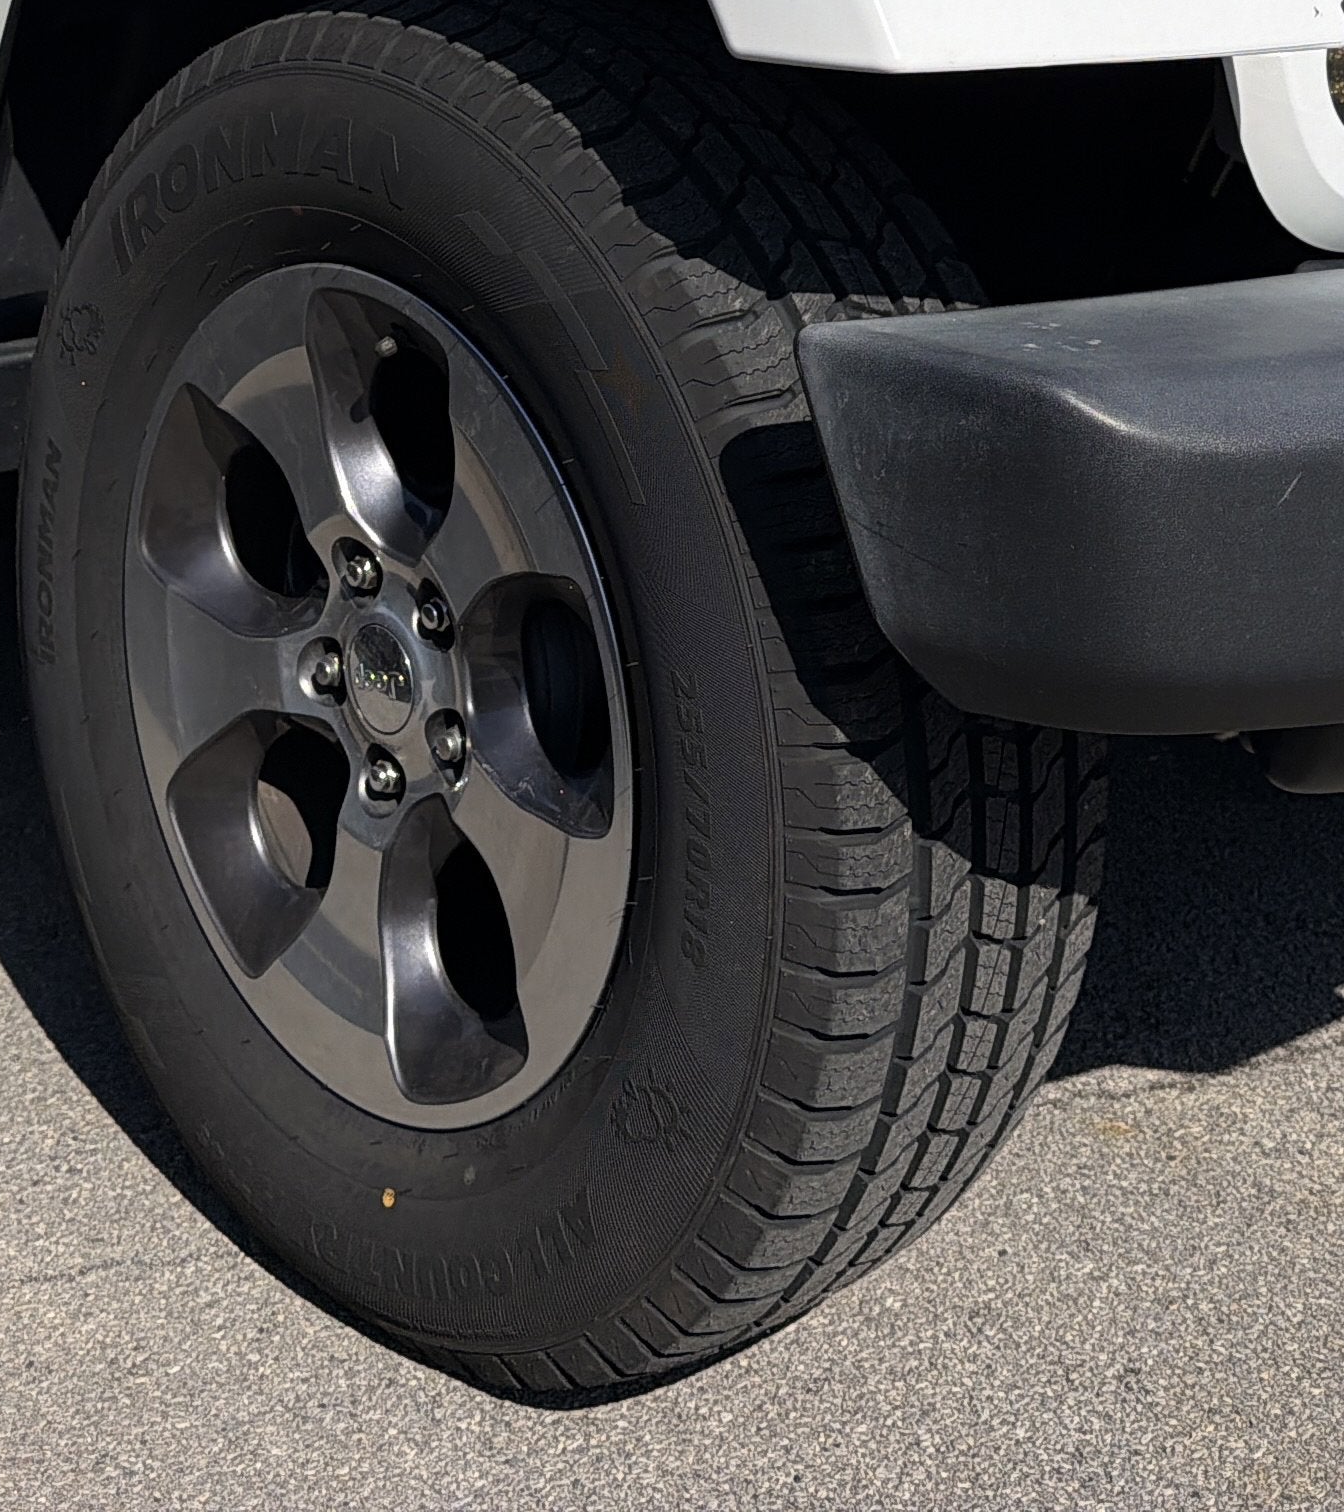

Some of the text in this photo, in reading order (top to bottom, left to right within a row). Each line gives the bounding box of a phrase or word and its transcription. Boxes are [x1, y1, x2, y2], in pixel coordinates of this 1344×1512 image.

[108, 110, 406, 278] IRONMAN
[35, 437, 62, 665] IRONMAN
[671, 668, 712, 970] 255/70R18
